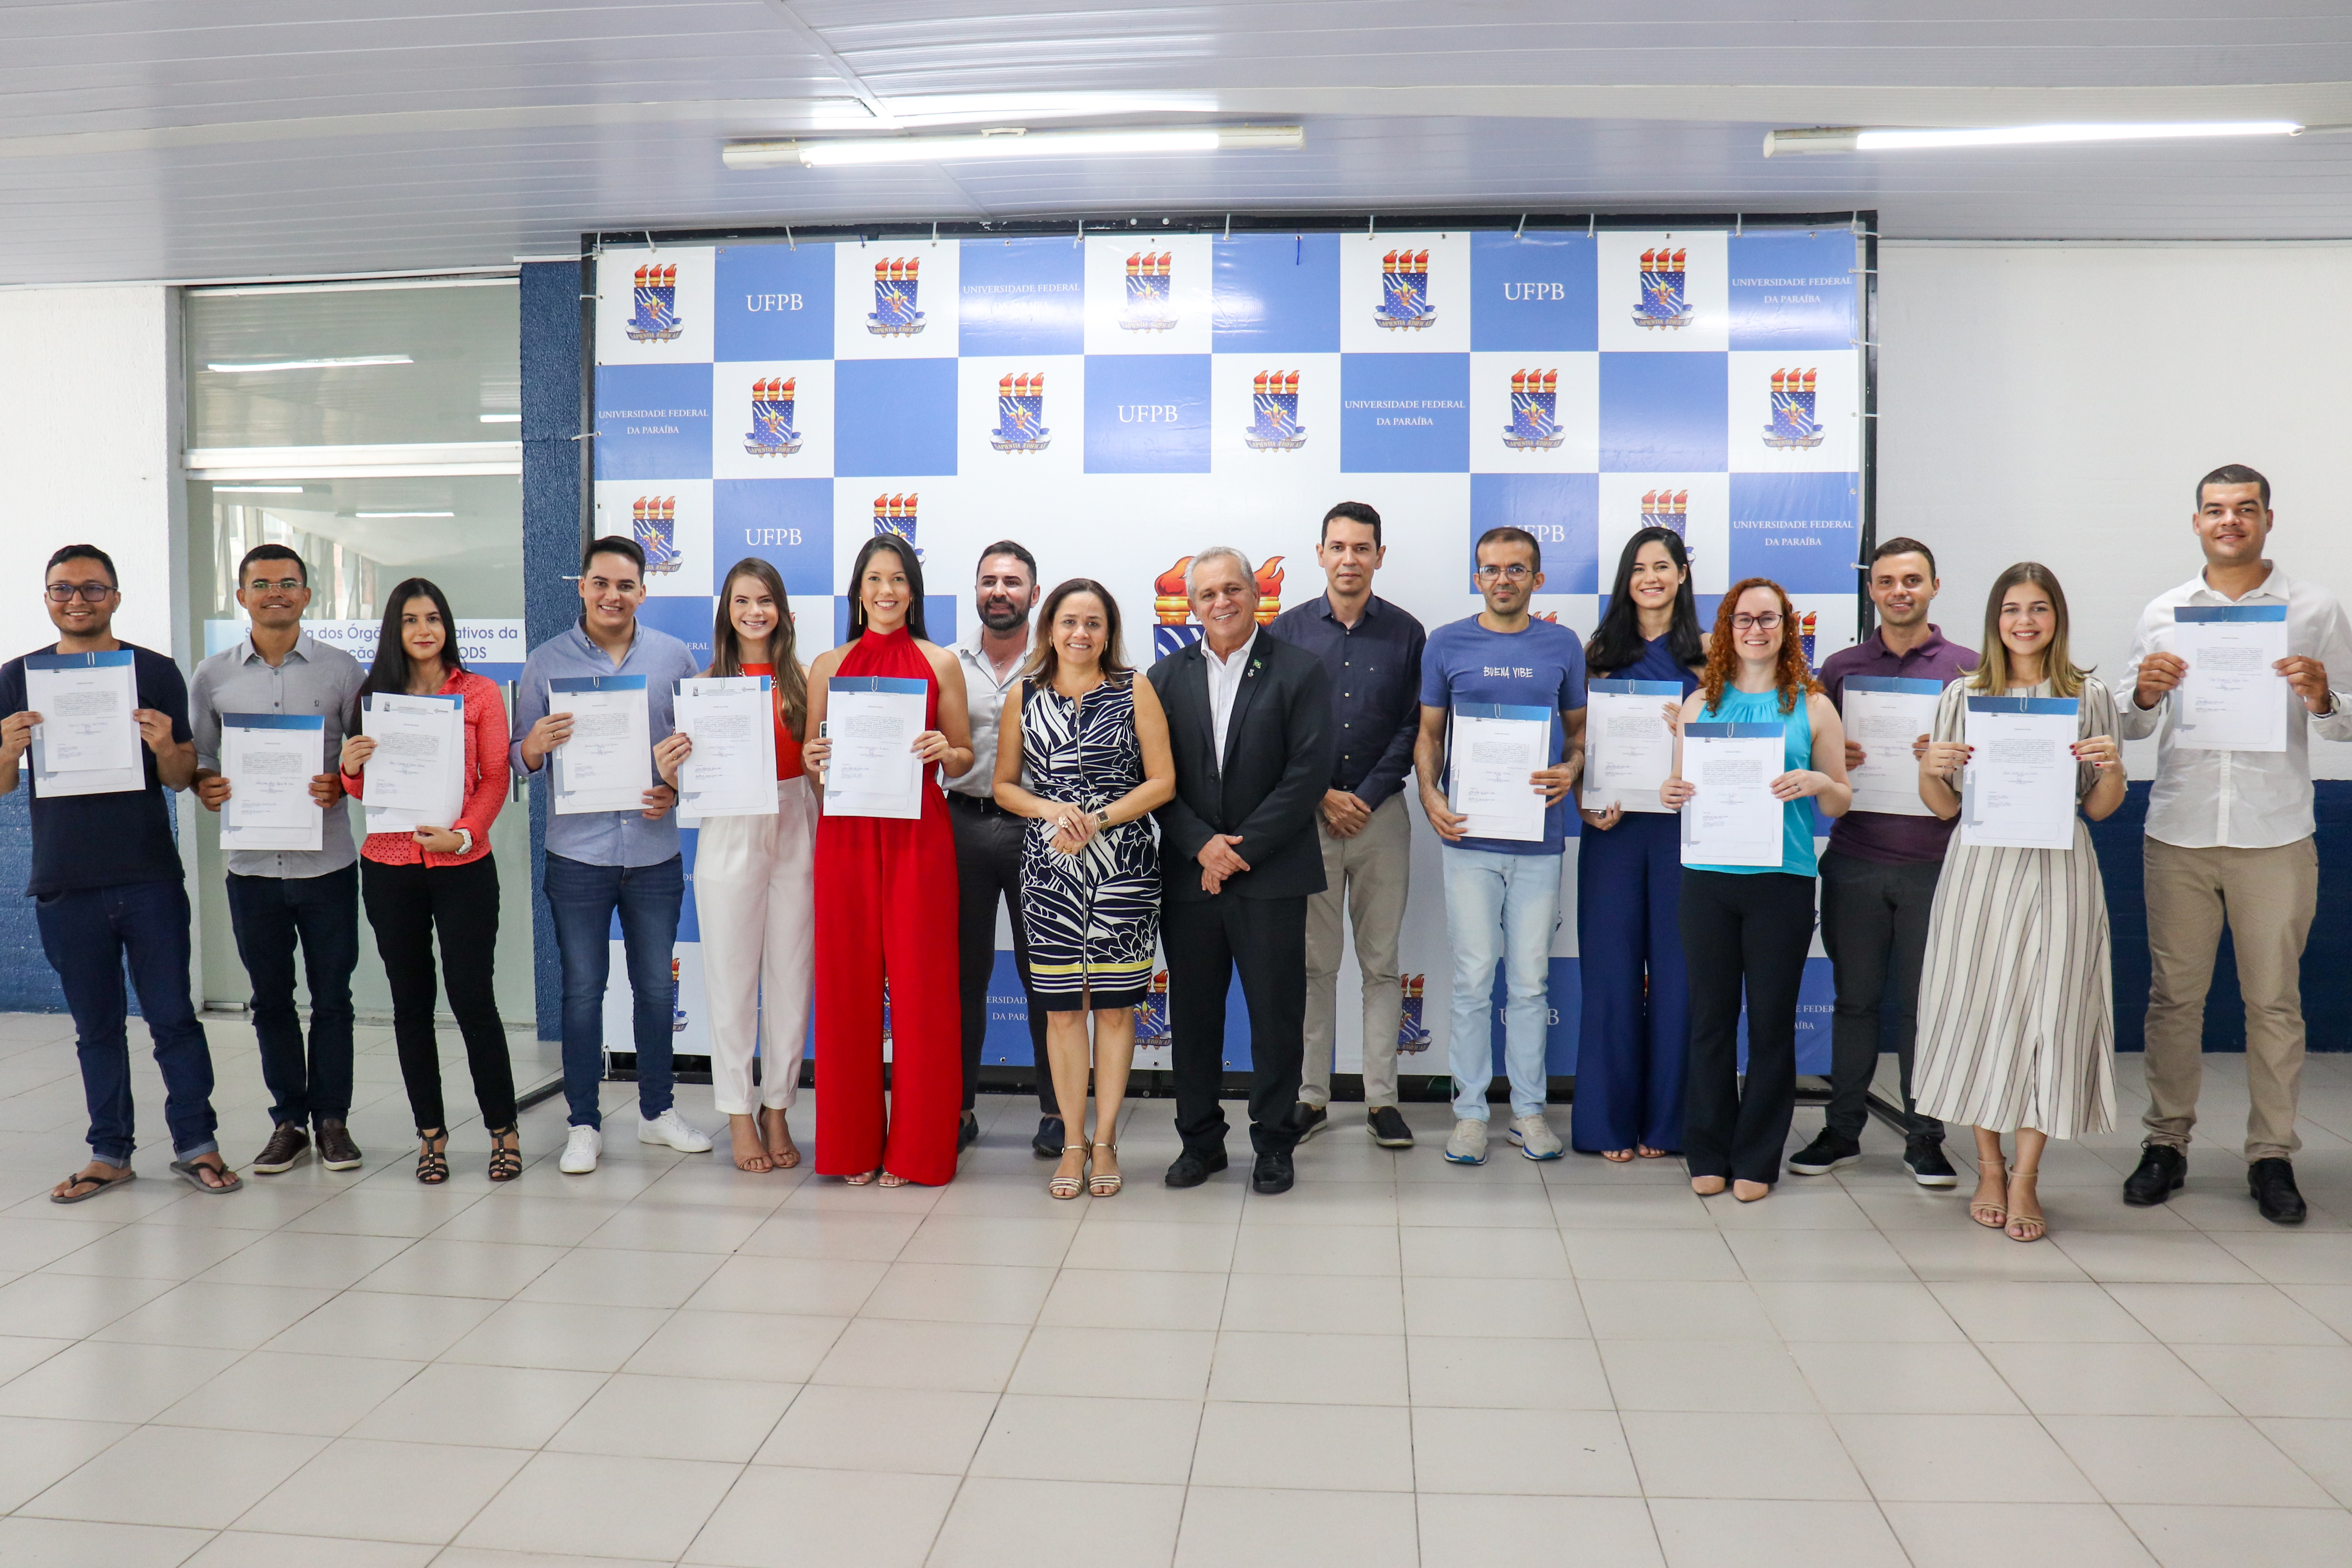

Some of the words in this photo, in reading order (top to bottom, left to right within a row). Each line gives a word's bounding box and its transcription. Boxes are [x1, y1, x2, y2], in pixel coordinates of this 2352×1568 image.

[1732, 278, 1807, 287] UNIVERSIDADE
[1809, 277, 1852, 285] FEDERAL
[963, 285, 1035, 294] UNIVERSIDADE
[1038, 283, 1080, 292] FEDERAL
[1503, 283, 1565, 301] UFPB
[746, 294, 803, 312] UFPB
[1781, 294, 1821, 303] PARAÍBA
[598, 410, 666, 419] UNIVERSIDADE
[668, 409, 708, 417] FEDERAL
[1118, 404, 1178, 423] UFPB
[1393, 416, 1433, 425] PARAÍBA
[642, 425, 679, 434] PARAÍBA
[745, 528, 802, 546] UFPB
[1503, 525, 1565, 542] PB
[1782, 536, 1822, 546] PARAÍBA
[318, 627, 343, 639] dos
[456, 627, 494, 639] ativos
[498, 626, 517, 639] da
[1483, 666, 1510, 679] BUENA
[1513, 667, 1533, 679] VIBE
[987, 996, 1027, 1004] ERSIDAD
[1803, 1005, 1835, 1013] FEDER
[1795, 1021, 1815, 1030] AÍBA
